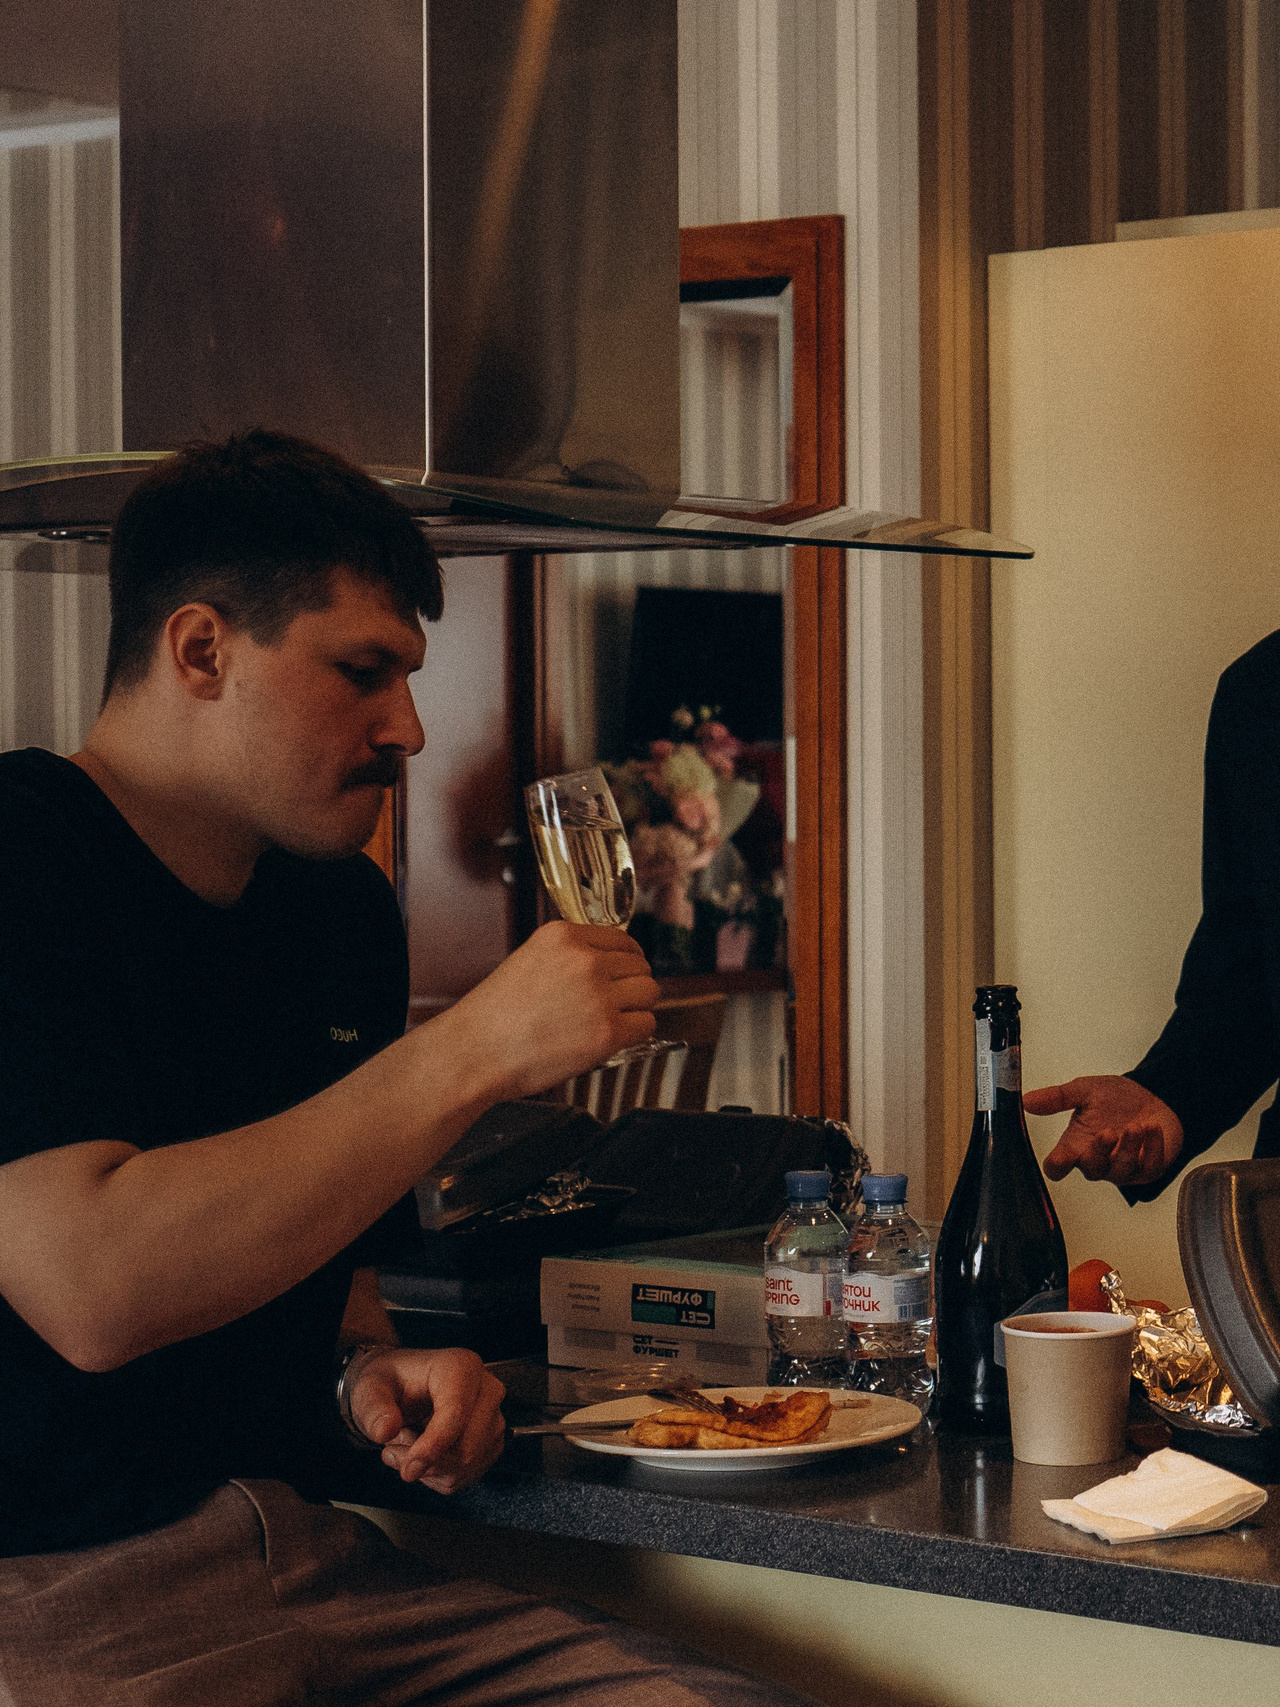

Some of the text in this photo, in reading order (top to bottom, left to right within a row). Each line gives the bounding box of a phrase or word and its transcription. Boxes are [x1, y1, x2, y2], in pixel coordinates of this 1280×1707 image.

[635, 1287, 703, 1307] ФУРШЕТ
[680, 1310, 712, 1326] СЕТ
[632, 1334, 654, 1345] СЕТ
[632, 1344, 680, 1359] ФУРШЕТ
